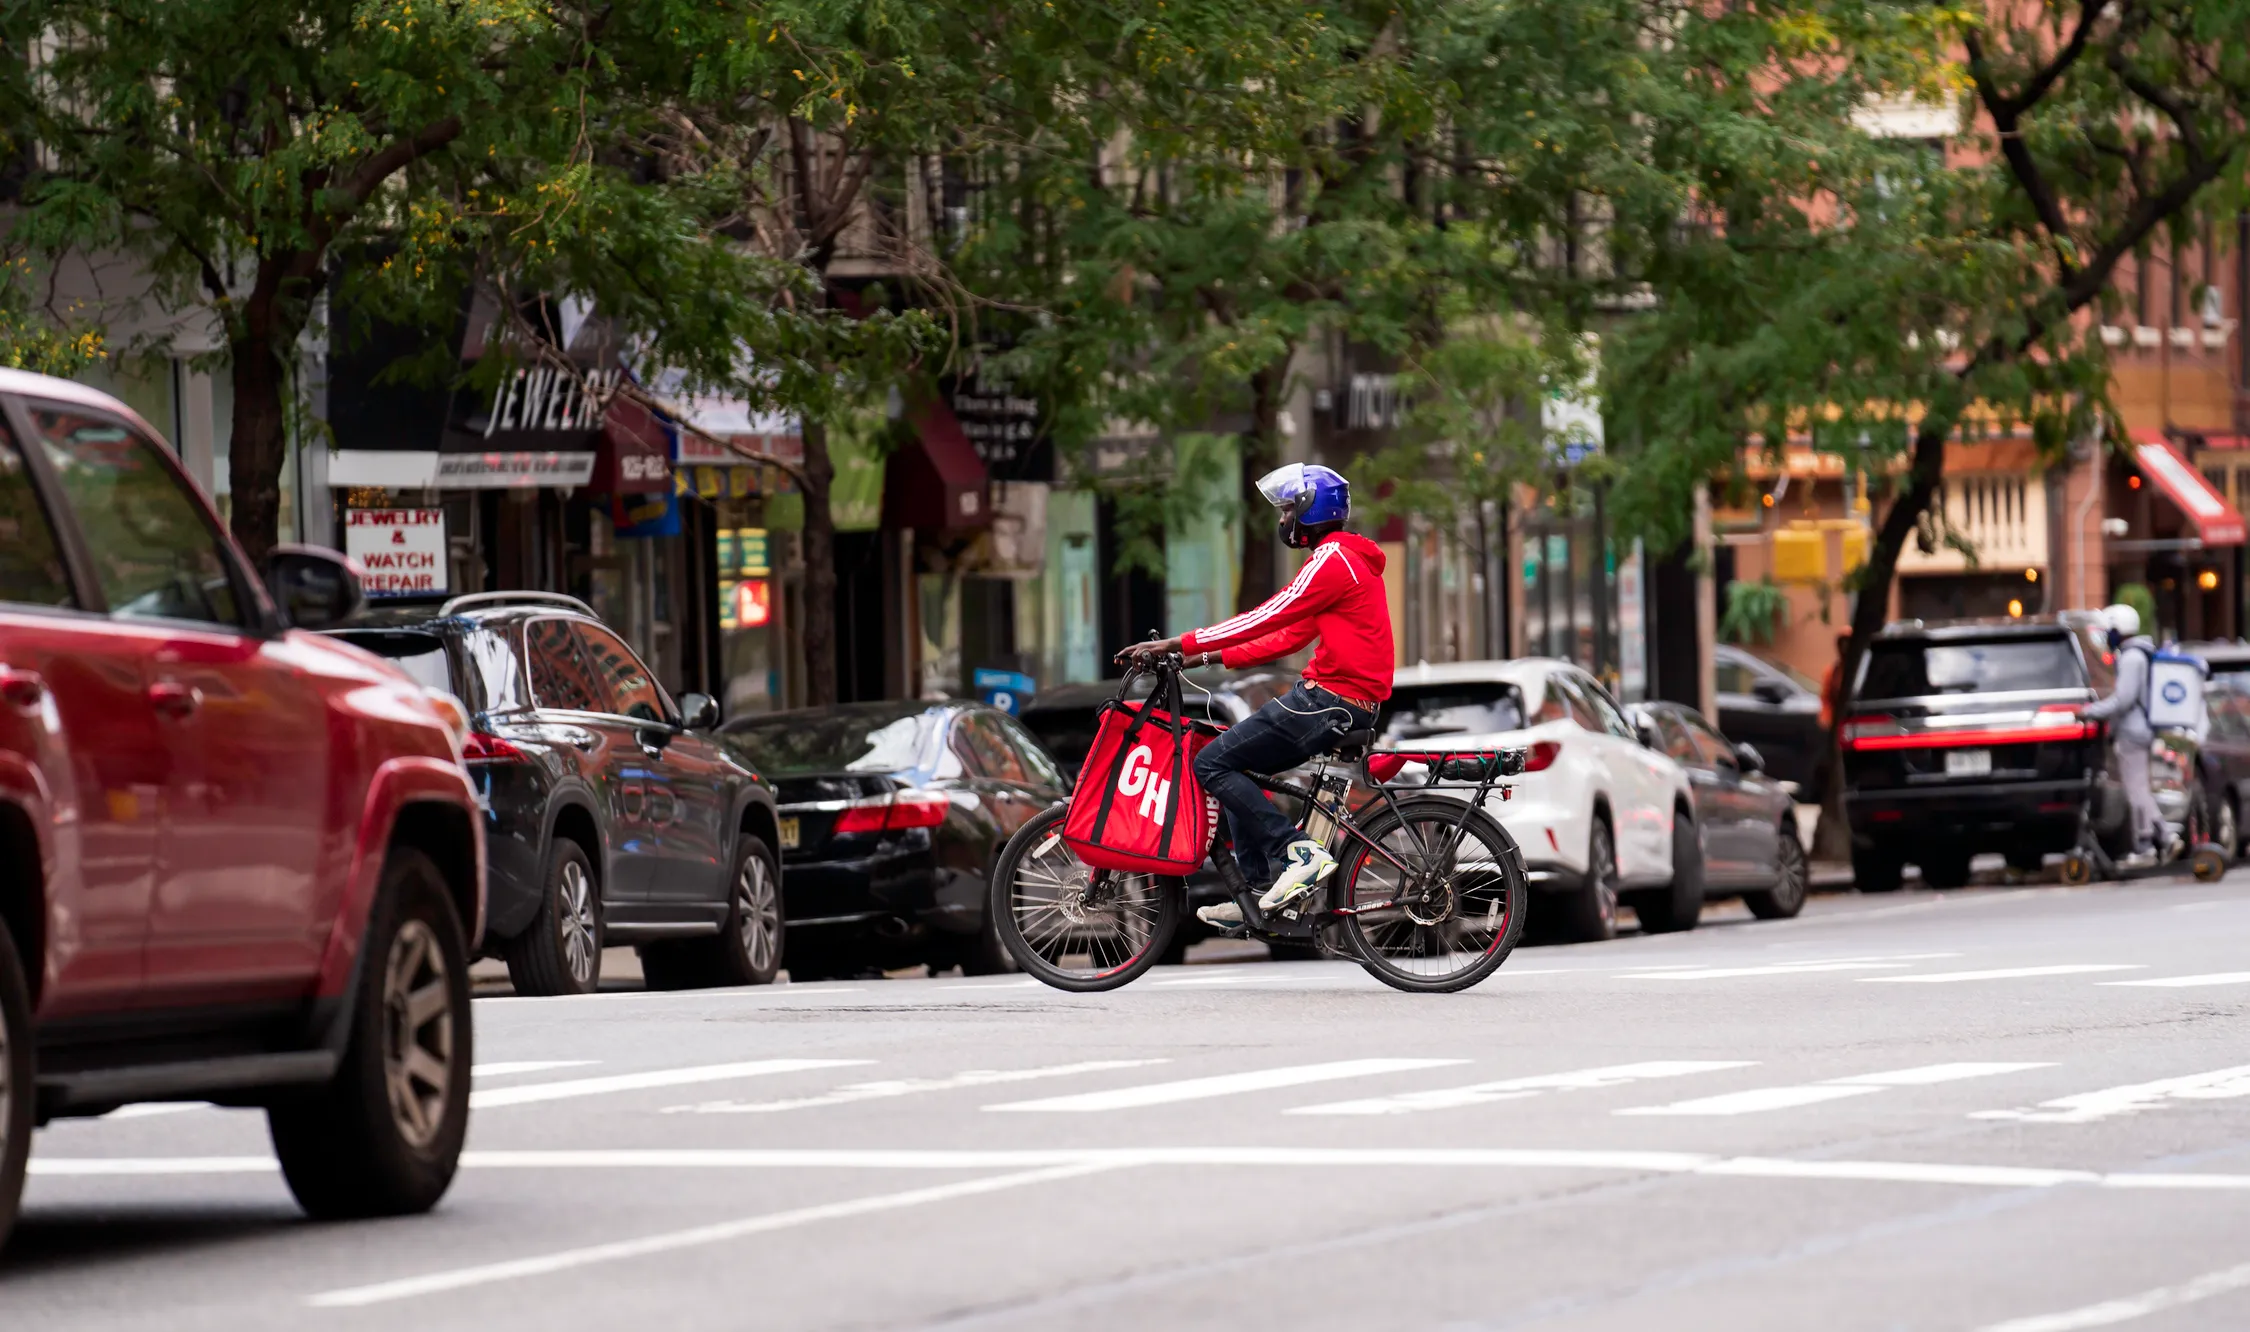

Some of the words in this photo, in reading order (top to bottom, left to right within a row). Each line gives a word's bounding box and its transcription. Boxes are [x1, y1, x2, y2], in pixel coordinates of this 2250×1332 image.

[484, 367, 621, 440] JEWELRY
[348, 509, 440, 526] JEWELRY
[391, 530, 405, 545] &
[363, 552, 435, 568] WATCH
[360, 573, 433, 590] REPAIR
[1118, 745, 1171, 827] GH
[1204, 788, 1220, 853] GRUB
